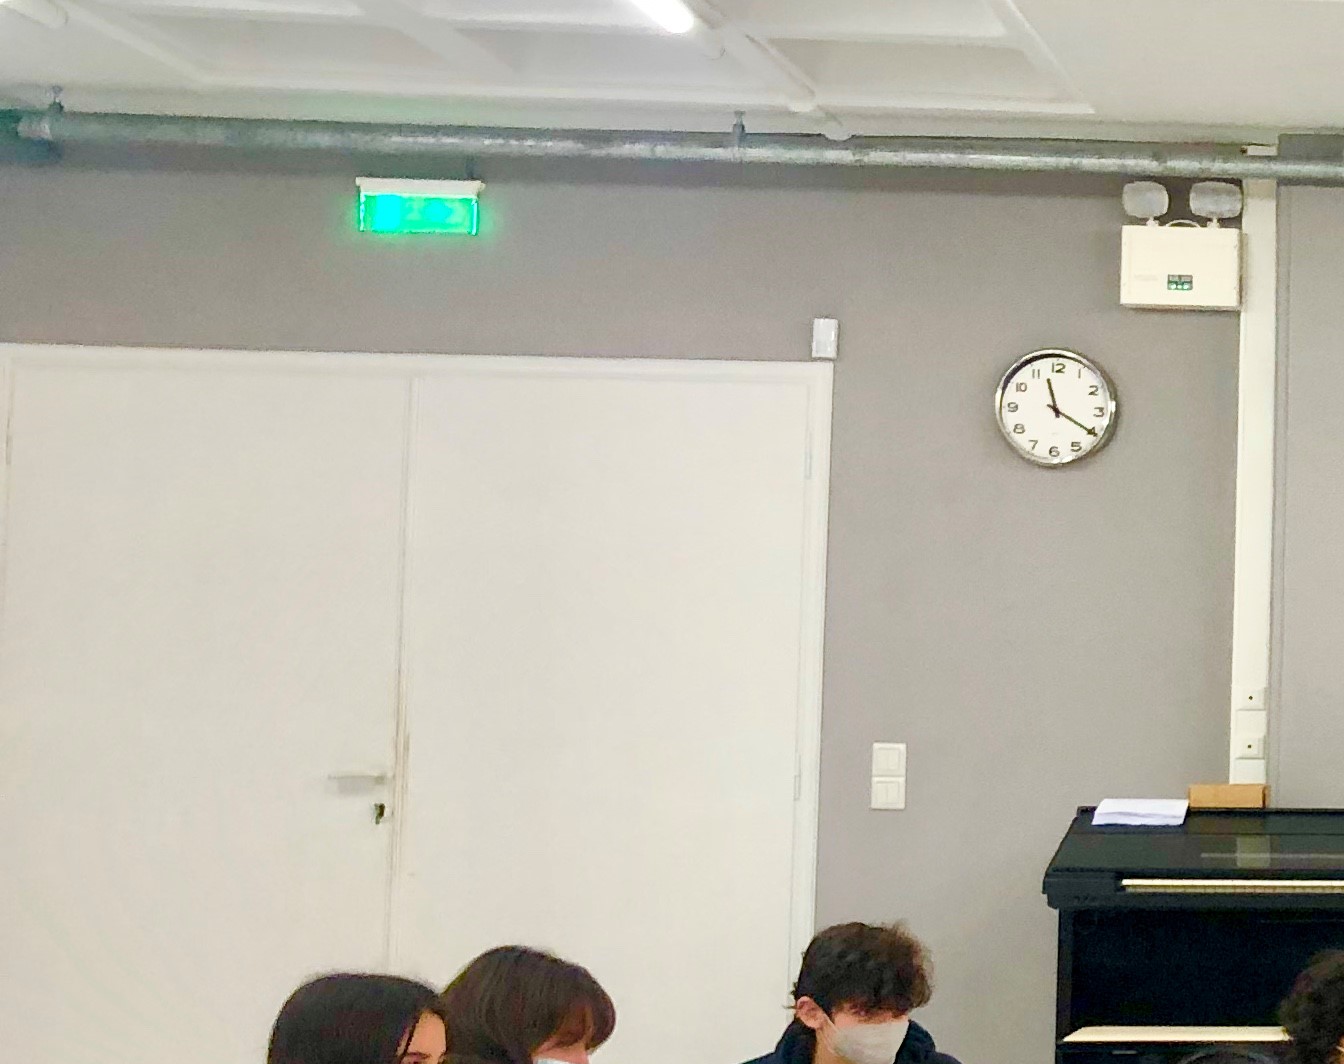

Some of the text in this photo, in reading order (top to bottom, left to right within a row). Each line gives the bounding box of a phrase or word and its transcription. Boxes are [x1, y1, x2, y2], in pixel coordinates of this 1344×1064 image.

[1051, 363, 1066, 373] 12
[1032, 369, 1040, 379] 11
[1016, 382, 1028, 392] 10
[1088, 385, 1099, 396] 2
[1007, 402, 1018, 412] 9
[1093, 407, 1105, 417] 3
[1013, 424, 1025, 434] 8
[1029, 440, 1038, 450] 7
[1071, 442, 1082, 452] 5
[1049, 446, 1060, 457] 6
